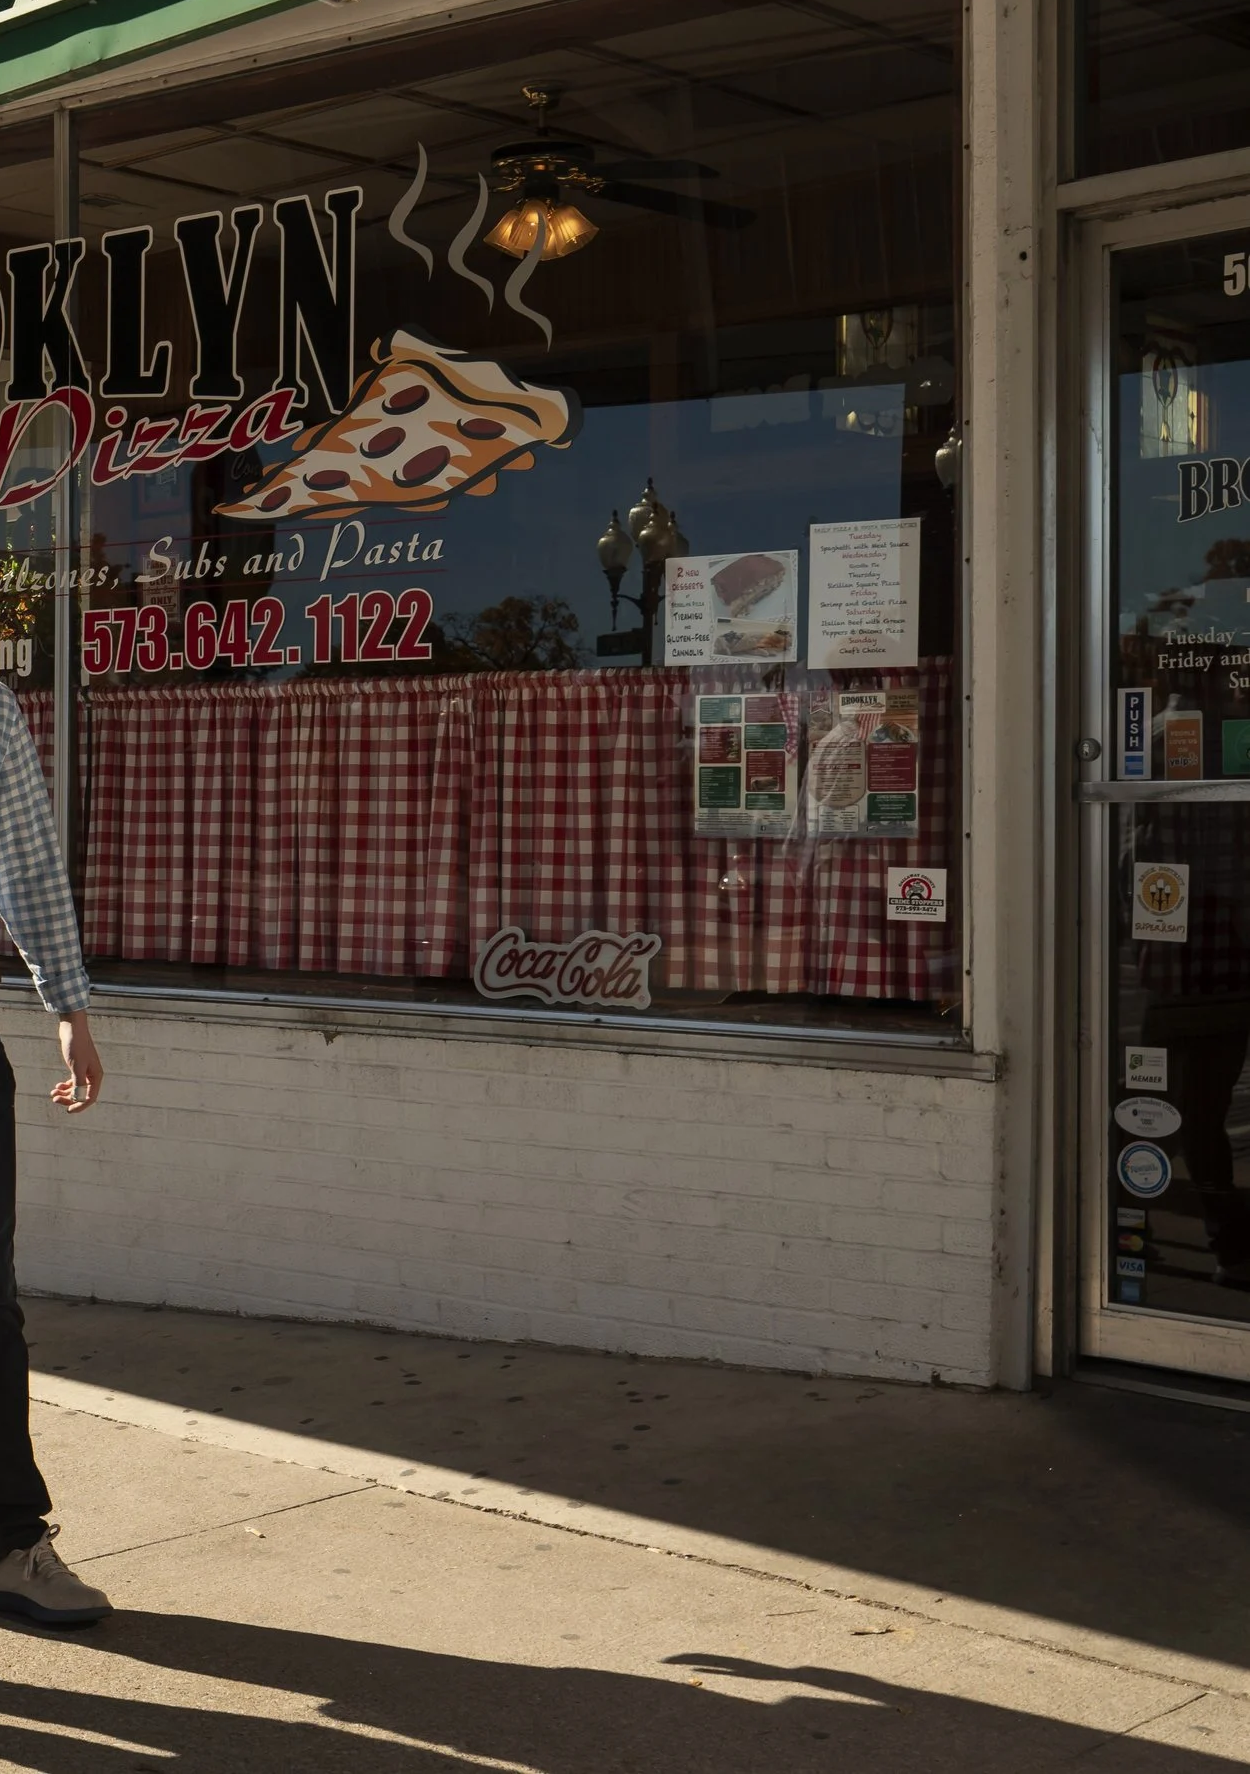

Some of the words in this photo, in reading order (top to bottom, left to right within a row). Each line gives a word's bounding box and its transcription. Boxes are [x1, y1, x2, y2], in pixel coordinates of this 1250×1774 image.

[1223, 252, 1250, 296] 5
[1177, 456, 1250, 523] BR
[848, 532, 882, 542] Tuesday
[135, 536, 229, 583] Subs
[242, 533, 305, 576] and
[319, 520, 445, 582] Pasta
[842, 551, 887, 560] Wednesday
[677, 567, 684, 578] 2
[685, 569, 700, 577] NEW
[848, 572, 881, 580] Thursday
[671, 582, 704, 591] DESSERTS
[850, 590, 878, 599] Friday
[673, 612, 703, 621] TIRAMISU
[846, 609, 881, 618] Saturday
[821, 619, 846, 627] Italian
[847, 618, 863, 626] Beef
[82, 588, 434, 675] 573.642.1122
[666, 633, 710, 644] GLUTEN-FREE
[848, 637, 878, 647] Sunday
[1164, 626, 1235, 648] Tuesday
[672, 648, 704, 657] CANNOLIS
[862, 646, 887, 654] Choice
[1157, 650, 1214, 672] Friday
[1220, 648, 1250, 667] and
[841, 695, 878, 706] BROOKLYN
[1129, 696, 1139, 747] PUSH
[1169, 757, 1189, 767] yelp
[480, 932, 655, 999] Coca-Cola
[1130, 1075, 1162, 1084] MEMBER
[1119, 1261, 1144, 1273] VISA
